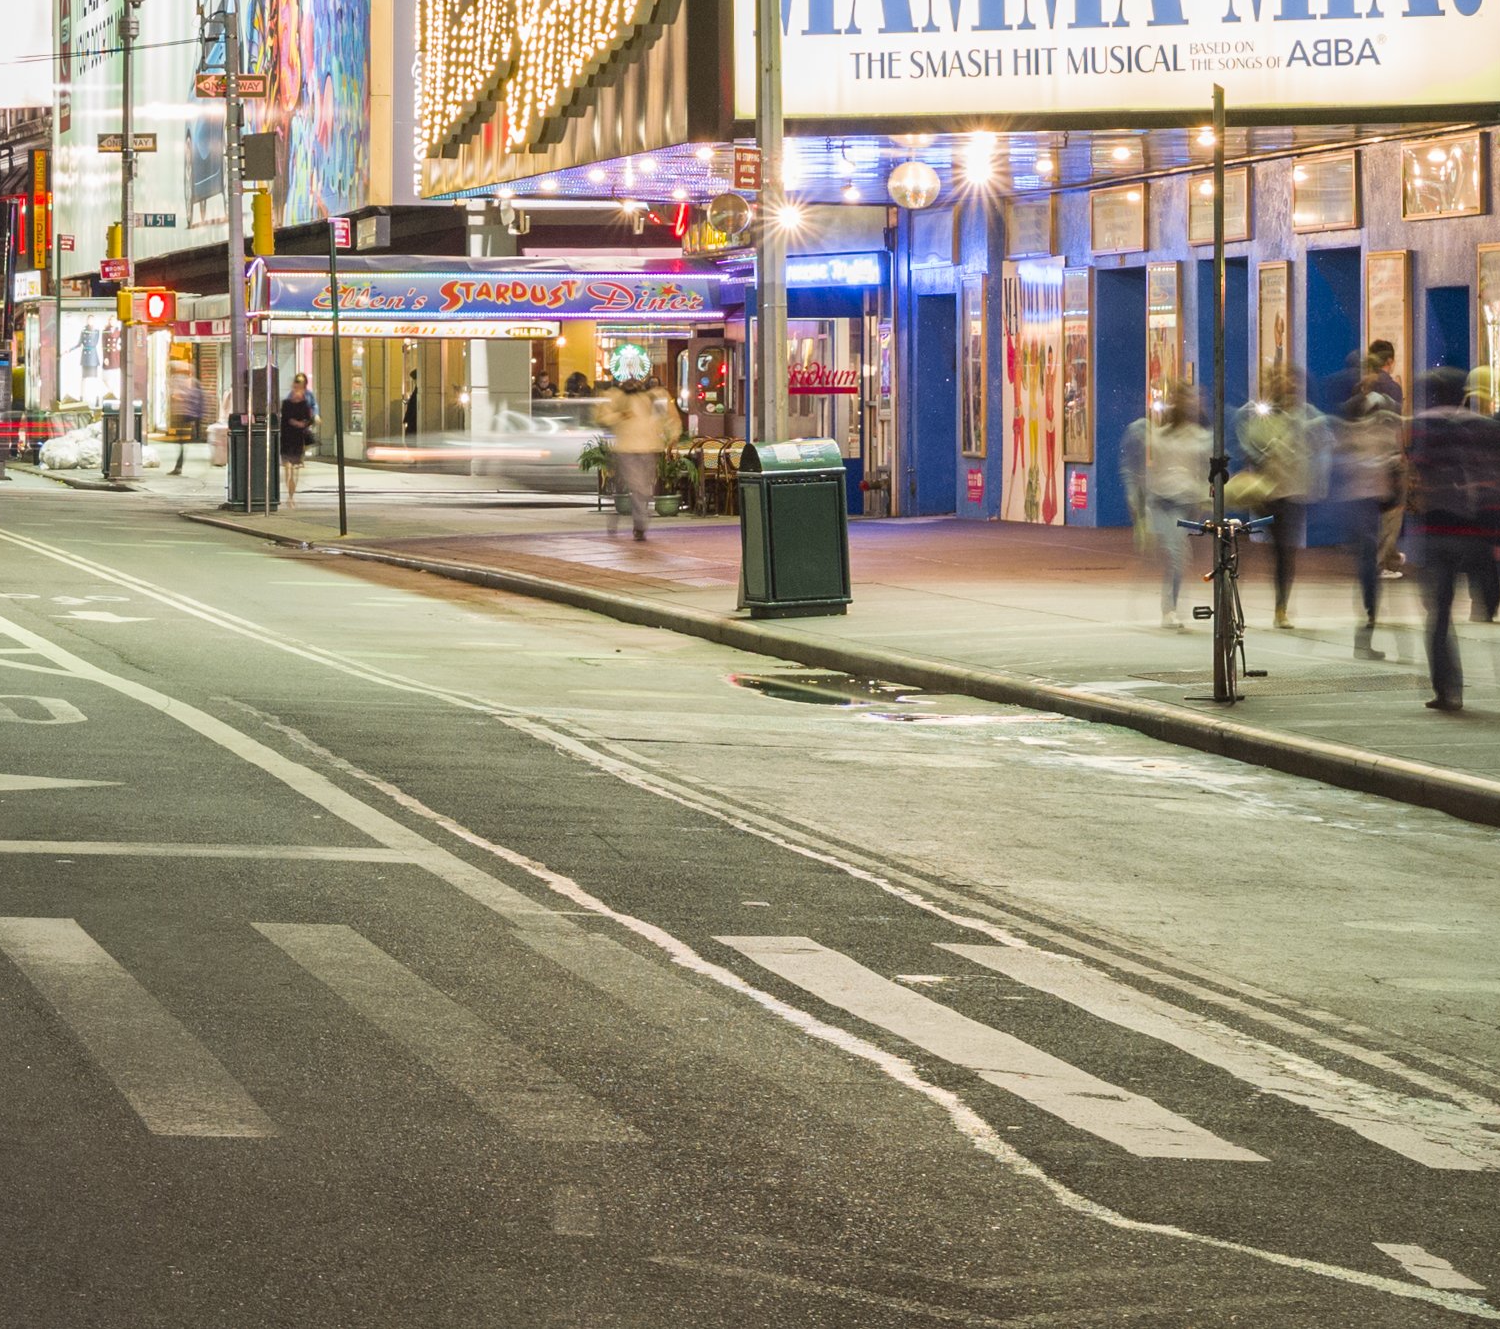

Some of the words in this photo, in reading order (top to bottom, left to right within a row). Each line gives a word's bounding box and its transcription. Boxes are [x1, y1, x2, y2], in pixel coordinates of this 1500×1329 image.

[1189, 41, 1230, 55] BASED
[1233, 40, 1255, 54] ON
[850, 51, 901, 80] THE
[909, 49, 1003, 79] SMASH
[1013, 46, 1057, 76] HIT
[1067, 42, 1185, 74] MUSICAL
[1189, 57, 1215, 71] THE
[1218, 56, 1264, 70] SONGS
[1267, 55, 1283, 69] OF
[146, 215, 154, 225] W
[155, 214, 165, 225] 51
[312, 283, 427, 312] Ellen's
[438, 279, 579, 312] STARDUST
[588, 280, 704, 312] Diner
